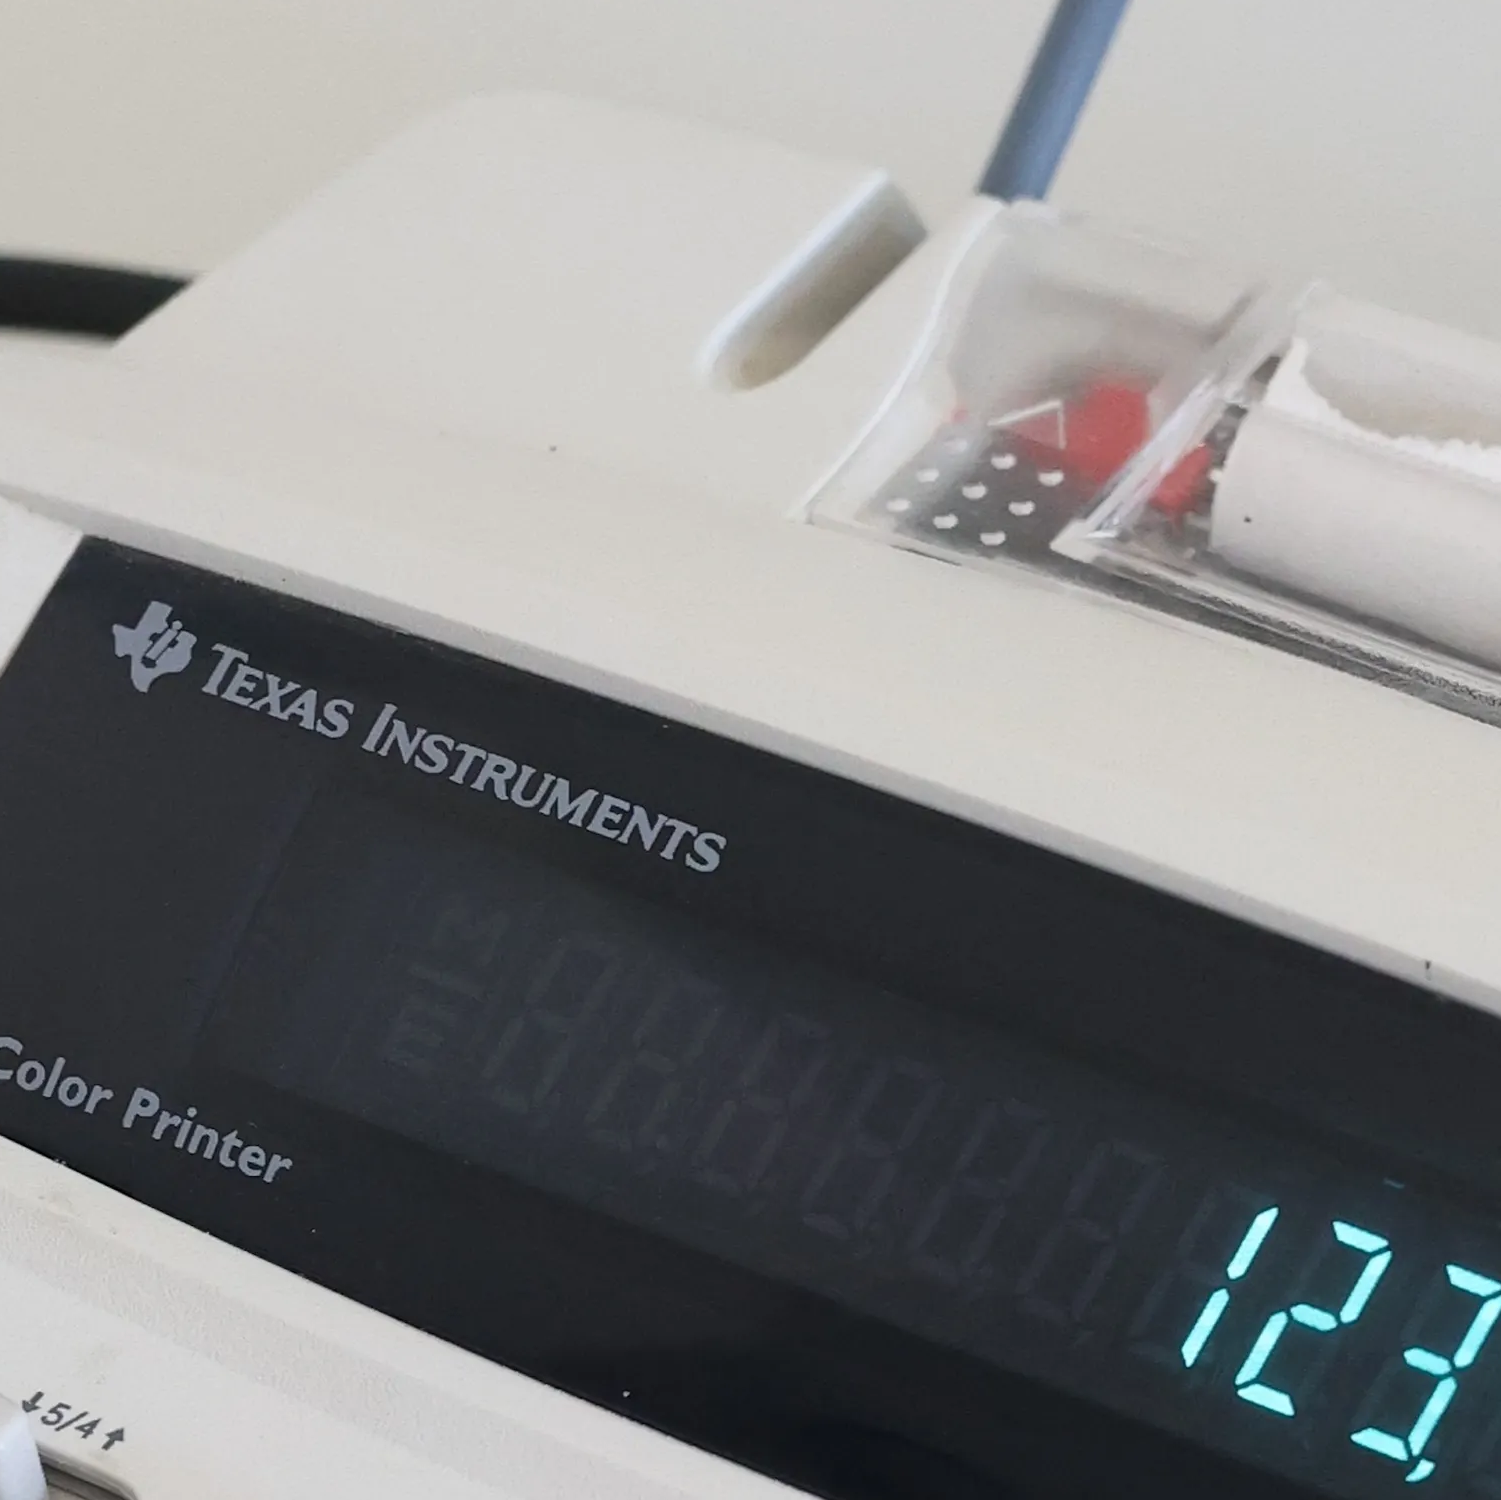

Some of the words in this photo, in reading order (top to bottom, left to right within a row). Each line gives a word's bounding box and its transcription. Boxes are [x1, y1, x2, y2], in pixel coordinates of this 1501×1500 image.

[201, 643, 354, 738] TEXAS
[362, 702, 728, 872] INSTRUMENTS
[122, 1087, 293, 1183] Printer
